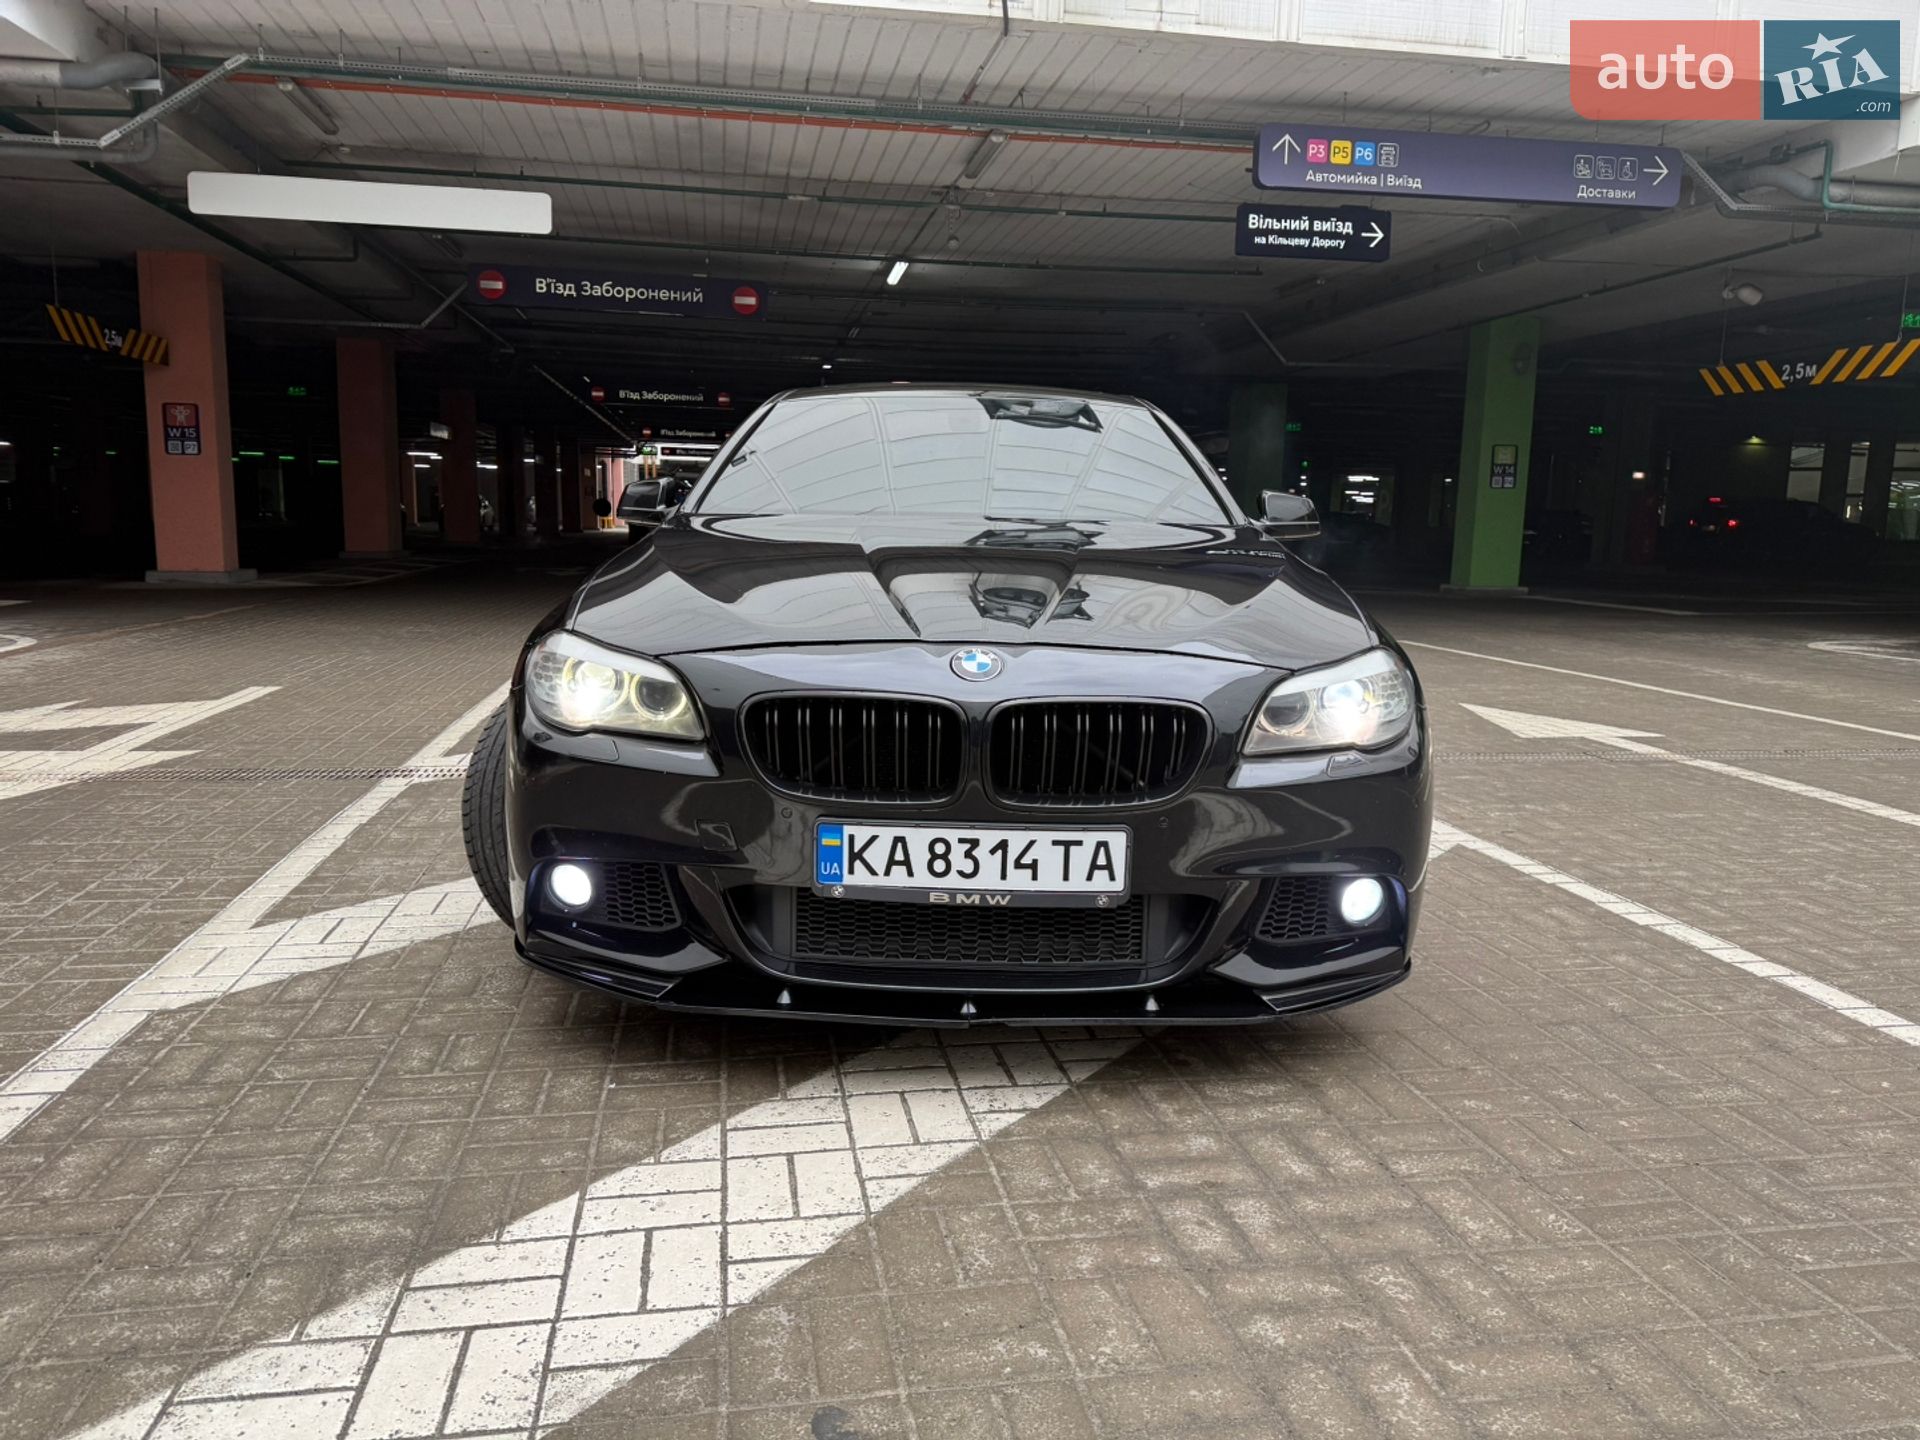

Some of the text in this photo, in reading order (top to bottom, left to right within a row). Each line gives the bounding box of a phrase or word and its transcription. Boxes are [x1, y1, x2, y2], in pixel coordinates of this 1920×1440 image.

[1308, 144, 1373, 160] P3 P5 P6
[1305, 169, 1377, 186] Автомийка
[1387, 173, 1422, 190] Виїзд
[1577, 184, 1636, 199] Доставки
[1248, 213, 1354, 235] Вільний виїзд
[1254, 234, 1346, 249] на Кільцеву Дорогу
[580, 281, 704, 303] Заборонений
[821, 861, 841, 875] UA
[929, 892, 1011, 905] BMW
